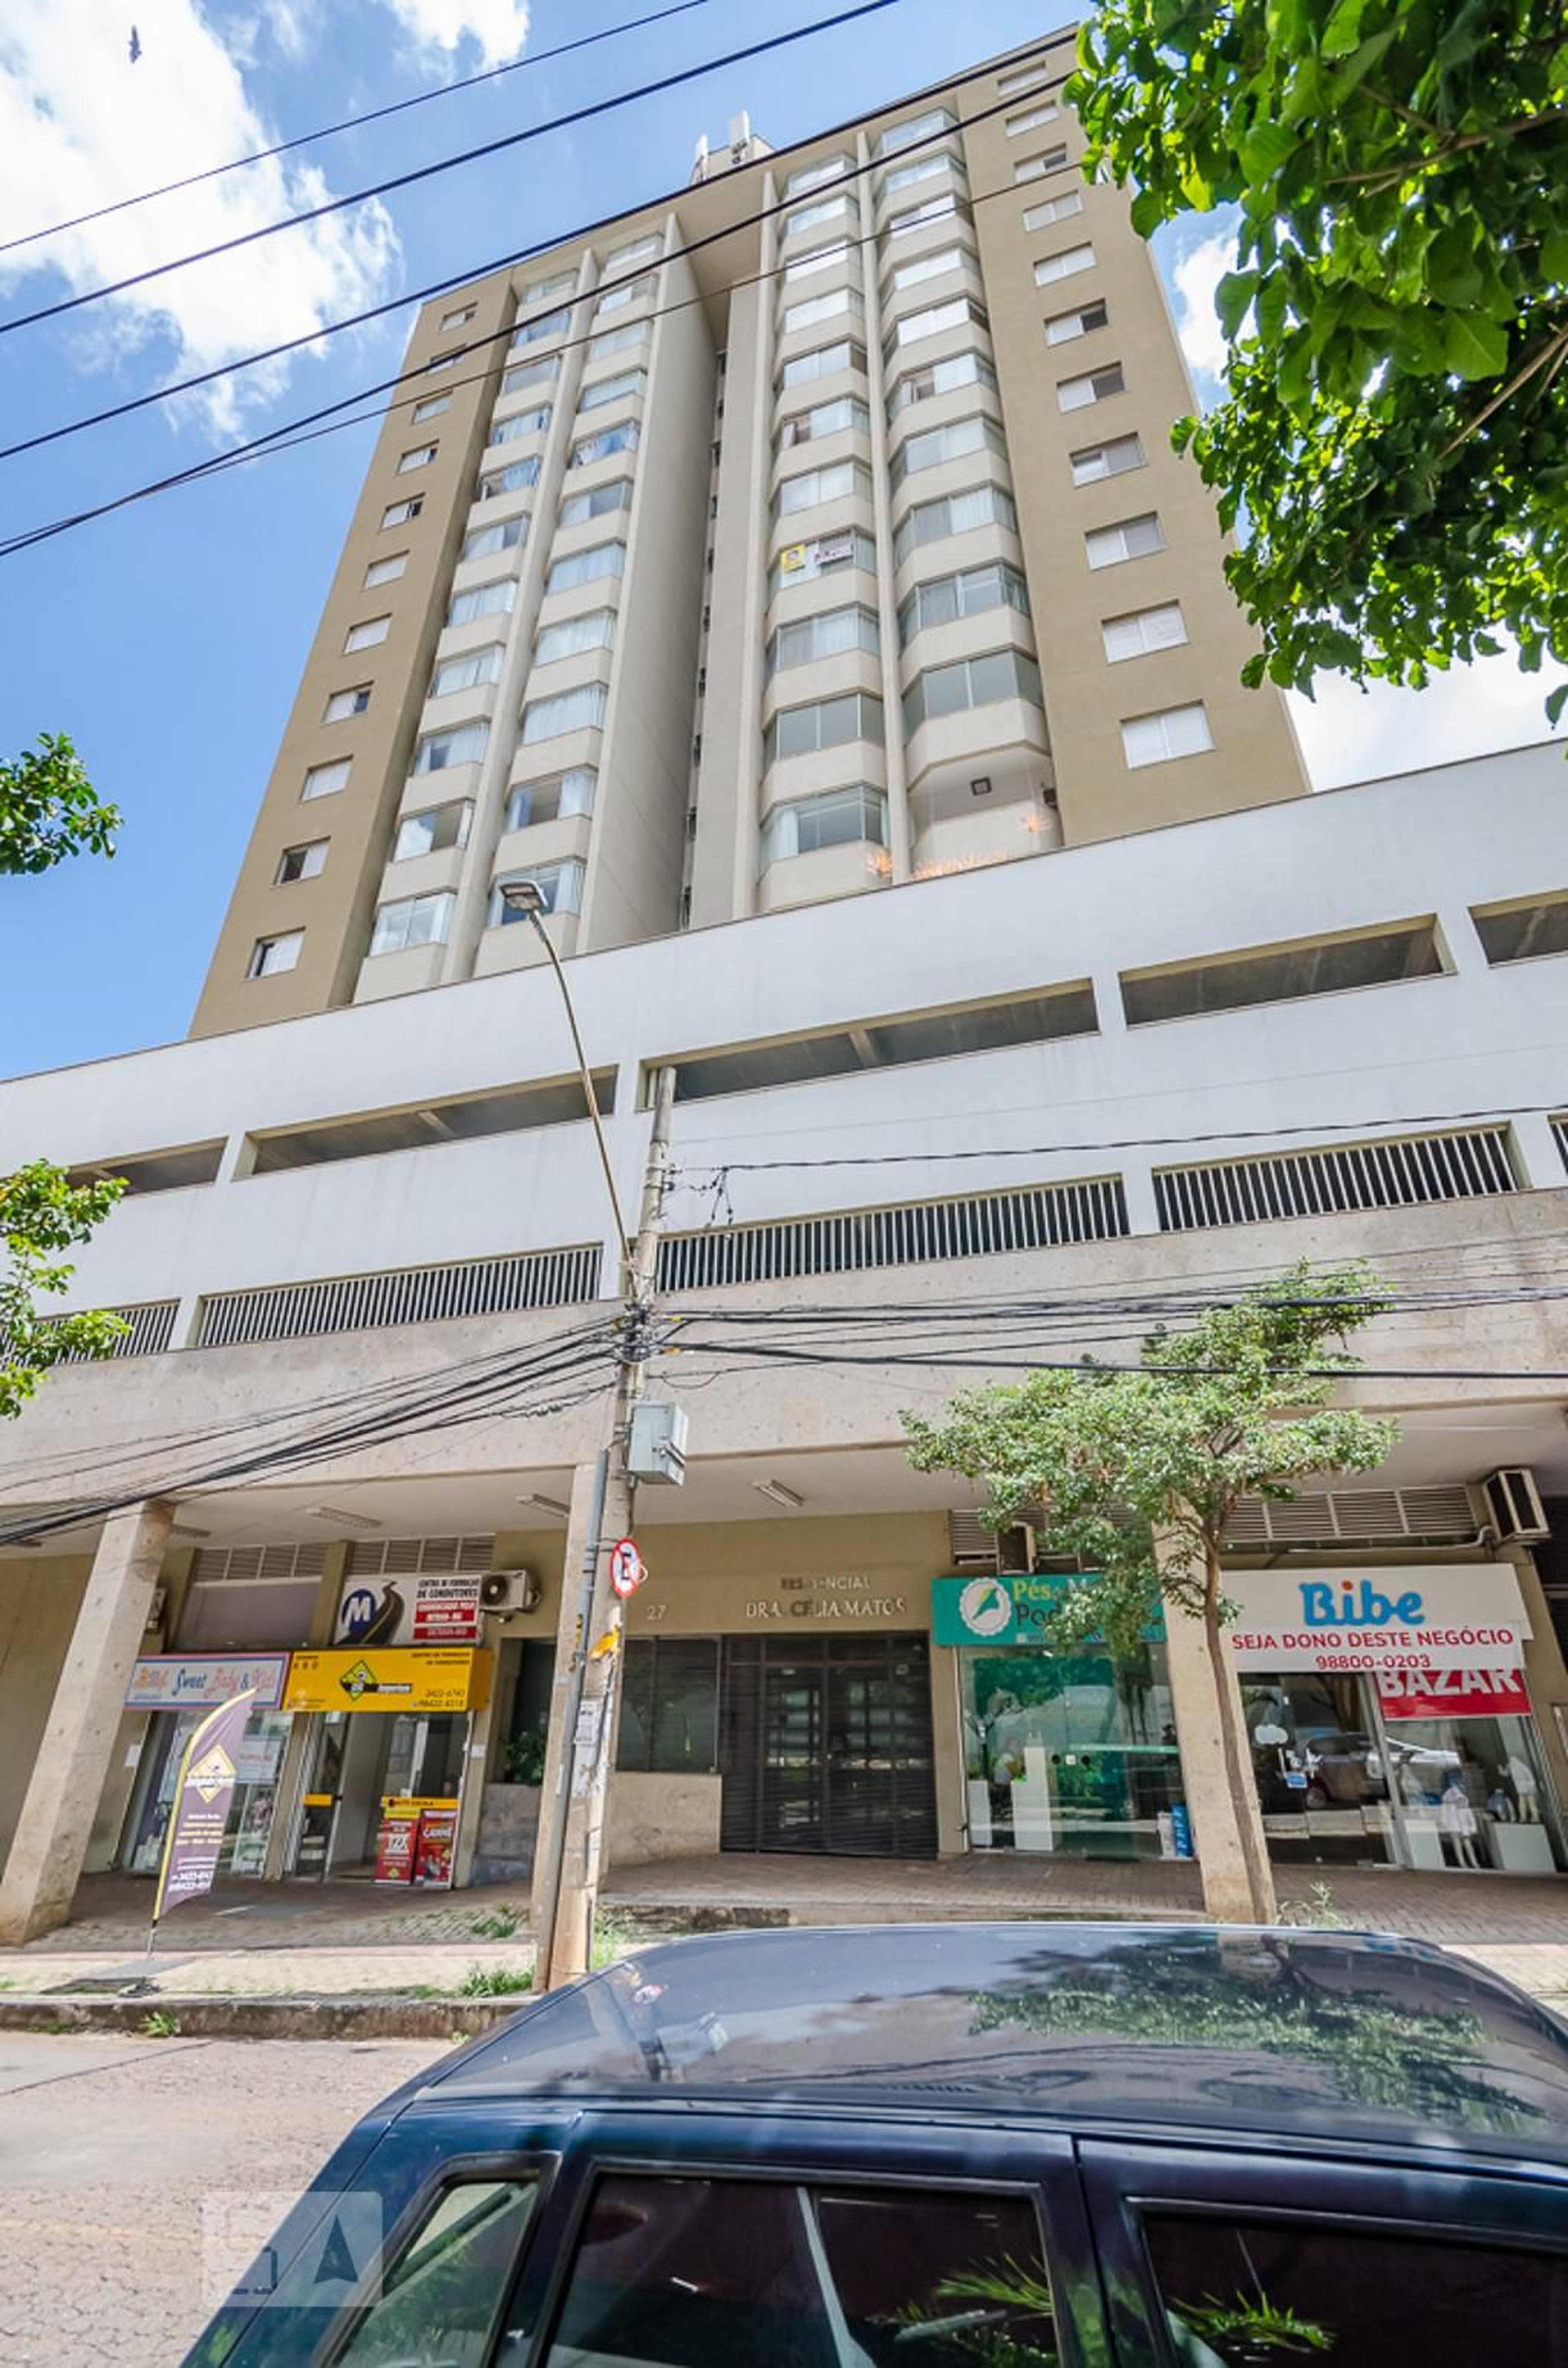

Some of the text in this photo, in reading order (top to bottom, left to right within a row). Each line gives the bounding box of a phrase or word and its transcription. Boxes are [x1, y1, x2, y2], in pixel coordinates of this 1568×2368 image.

[1012, 1578, 1051, 1601] Pés
[647, 1604, 667, 1621] 27
[1299, 1579, 1425, 1627] Bibe
[1232, 1625, 1513, 1650] SEJA DONO DESTE NEGÓCIO
[1316, 1654, 1432, 1670] 98800-0203
[172, 1667, 207, 1696] Sweet
[1381, 1669, 1521, 1696] BAZAR
